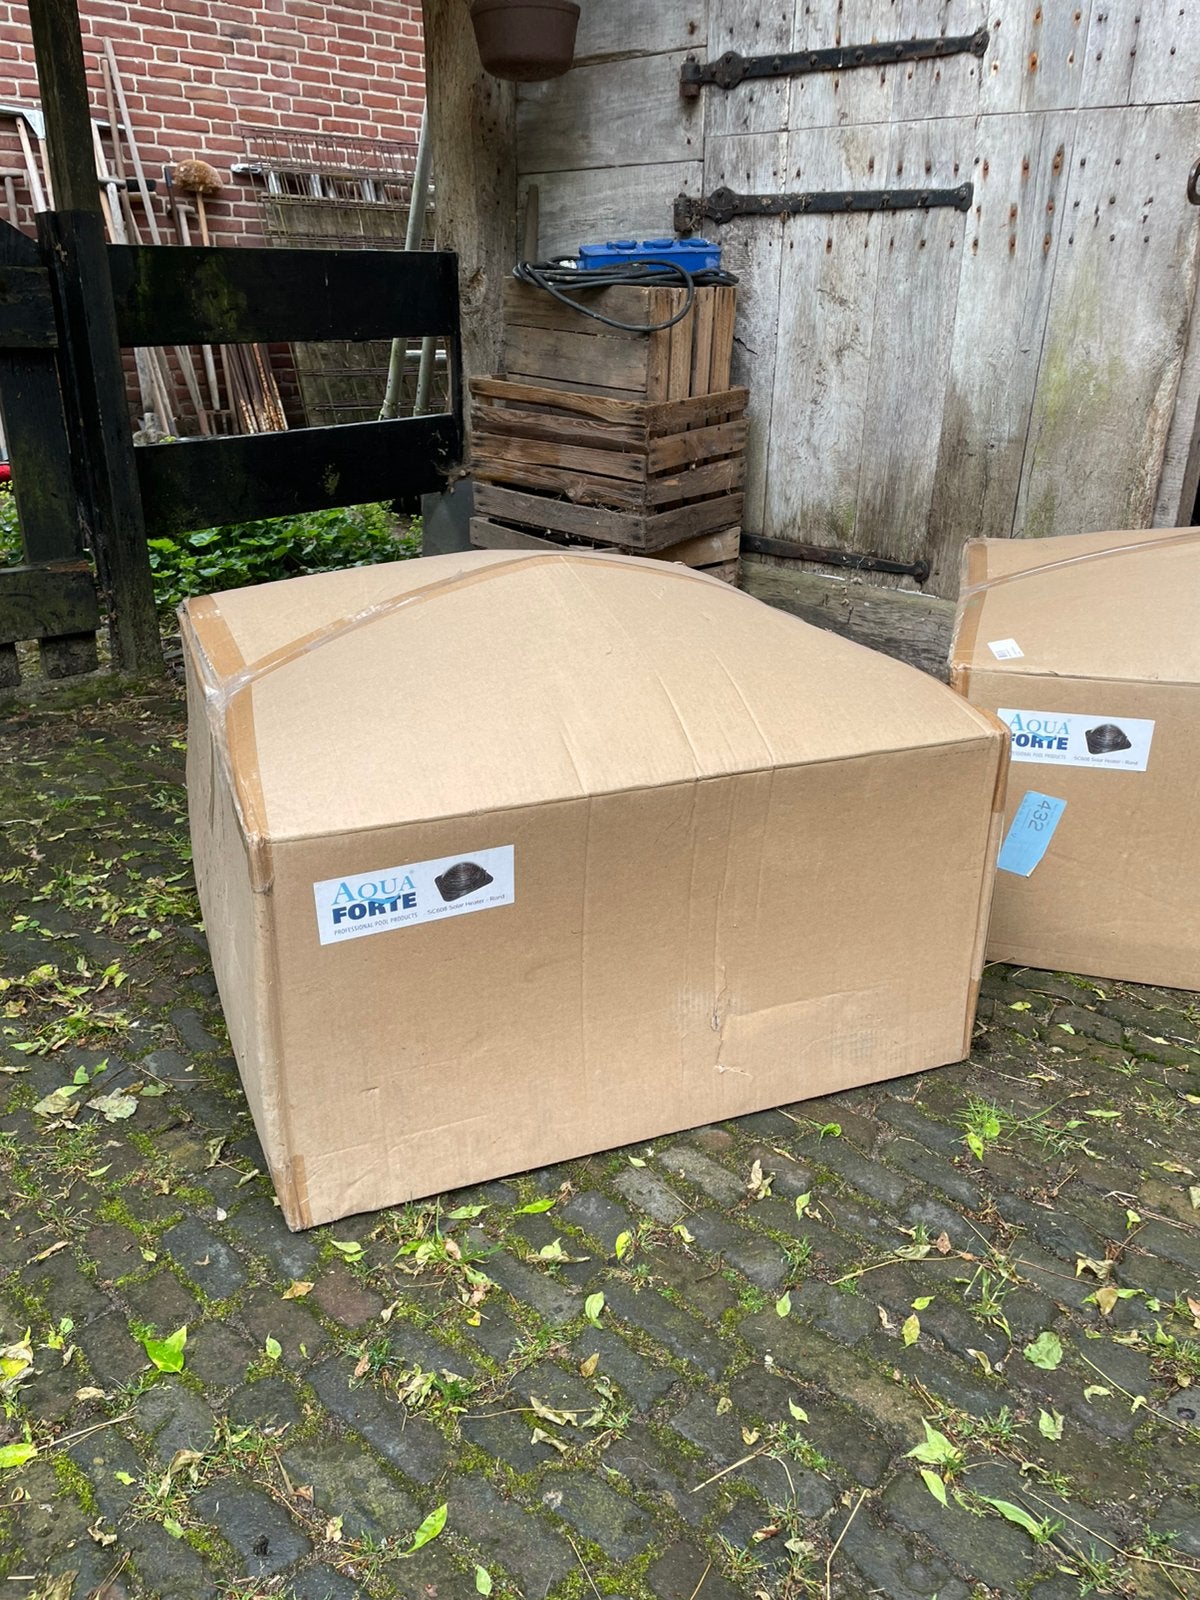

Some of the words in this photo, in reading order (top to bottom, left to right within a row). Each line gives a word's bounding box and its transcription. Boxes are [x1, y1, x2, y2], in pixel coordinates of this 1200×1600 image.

[1009, 713, 1069, 738] AQUA
[1028, 800, 1051, 831] 432
[331, 875, 416, 905] AQUA
[332, 892, 417, 924] FORTE
[449, 902, 465, 911] Solar
[334, 923, 373, 936] PROFESSIONAL
[375, 919, 388, 928] POOL
[390, 912, 418, 923] PRODUCTS
